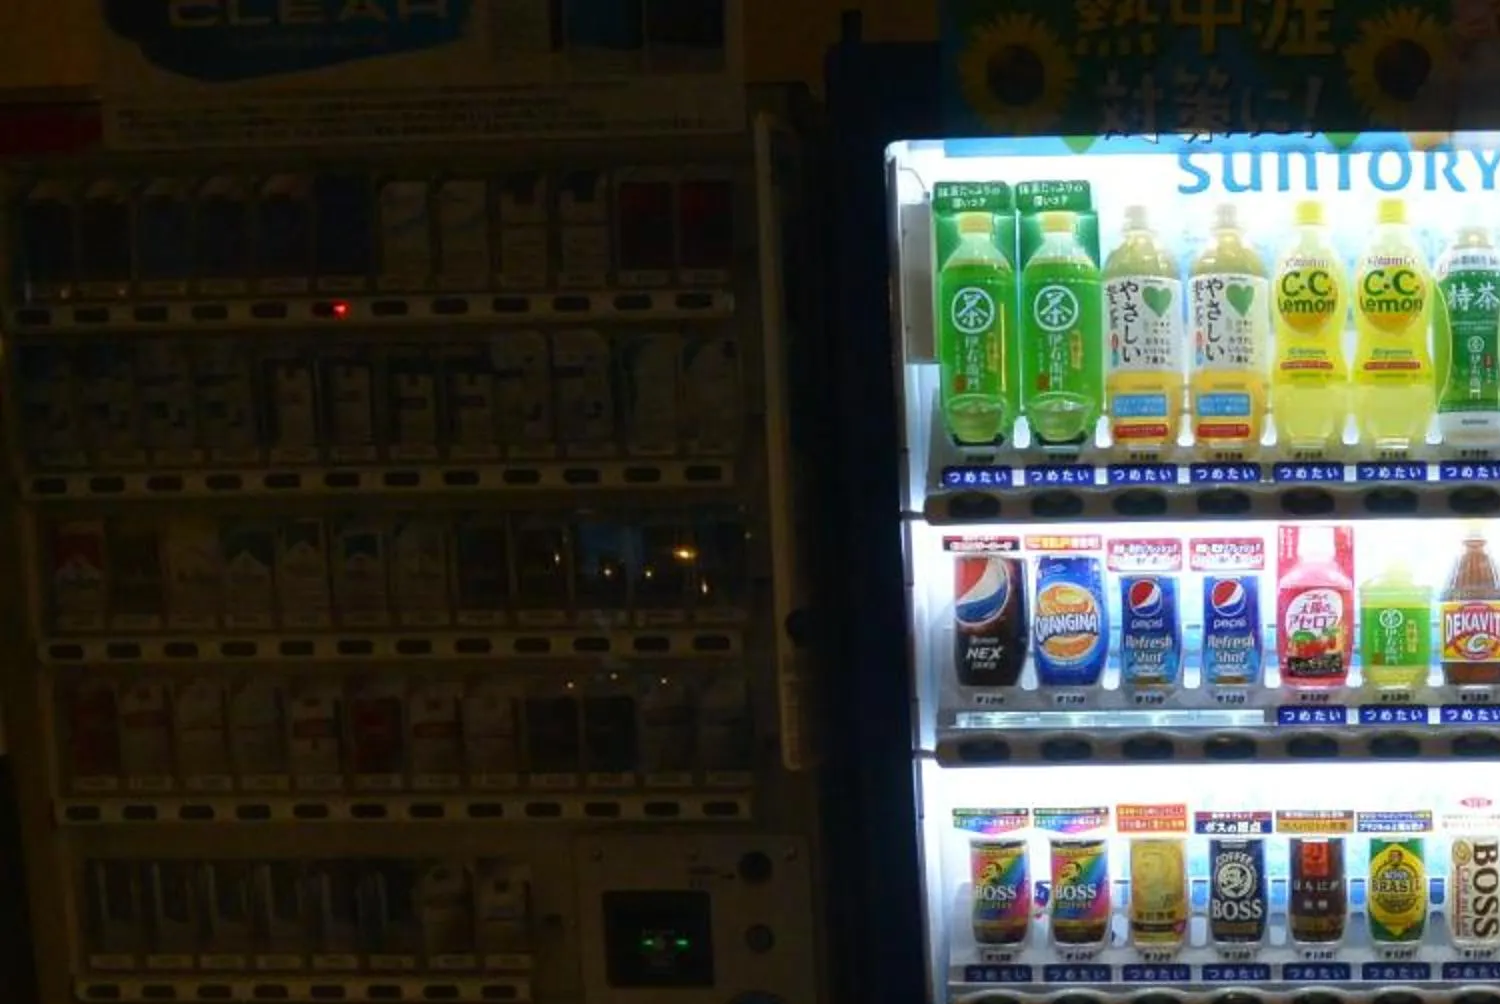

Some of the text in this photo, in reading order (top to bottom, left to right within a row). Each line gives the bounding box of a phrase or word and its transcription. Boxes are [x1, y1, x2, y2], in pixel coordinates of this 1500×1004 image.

[1119, 280, 1142, 363] やさしい
[1205, 278, 1225, 362] やさしい
[948, 471, 1007, 484] つめたい
[1030, 470, 1089, 483] つめたい
[1113, 469, 1172, 482] つめたい
[1195, 468, 1256, 481] つめたい
[1279, 466, 1340, 479] つめたい
[1363, 466, 1422, 479] つめたい
[1283, 711, 1341, 722] つめたい
[1365, 710, 1423, 721] つめたい
[1472, 843, 1499, 938] BOSS
[1212, 898, 1263, 920] BOSS
